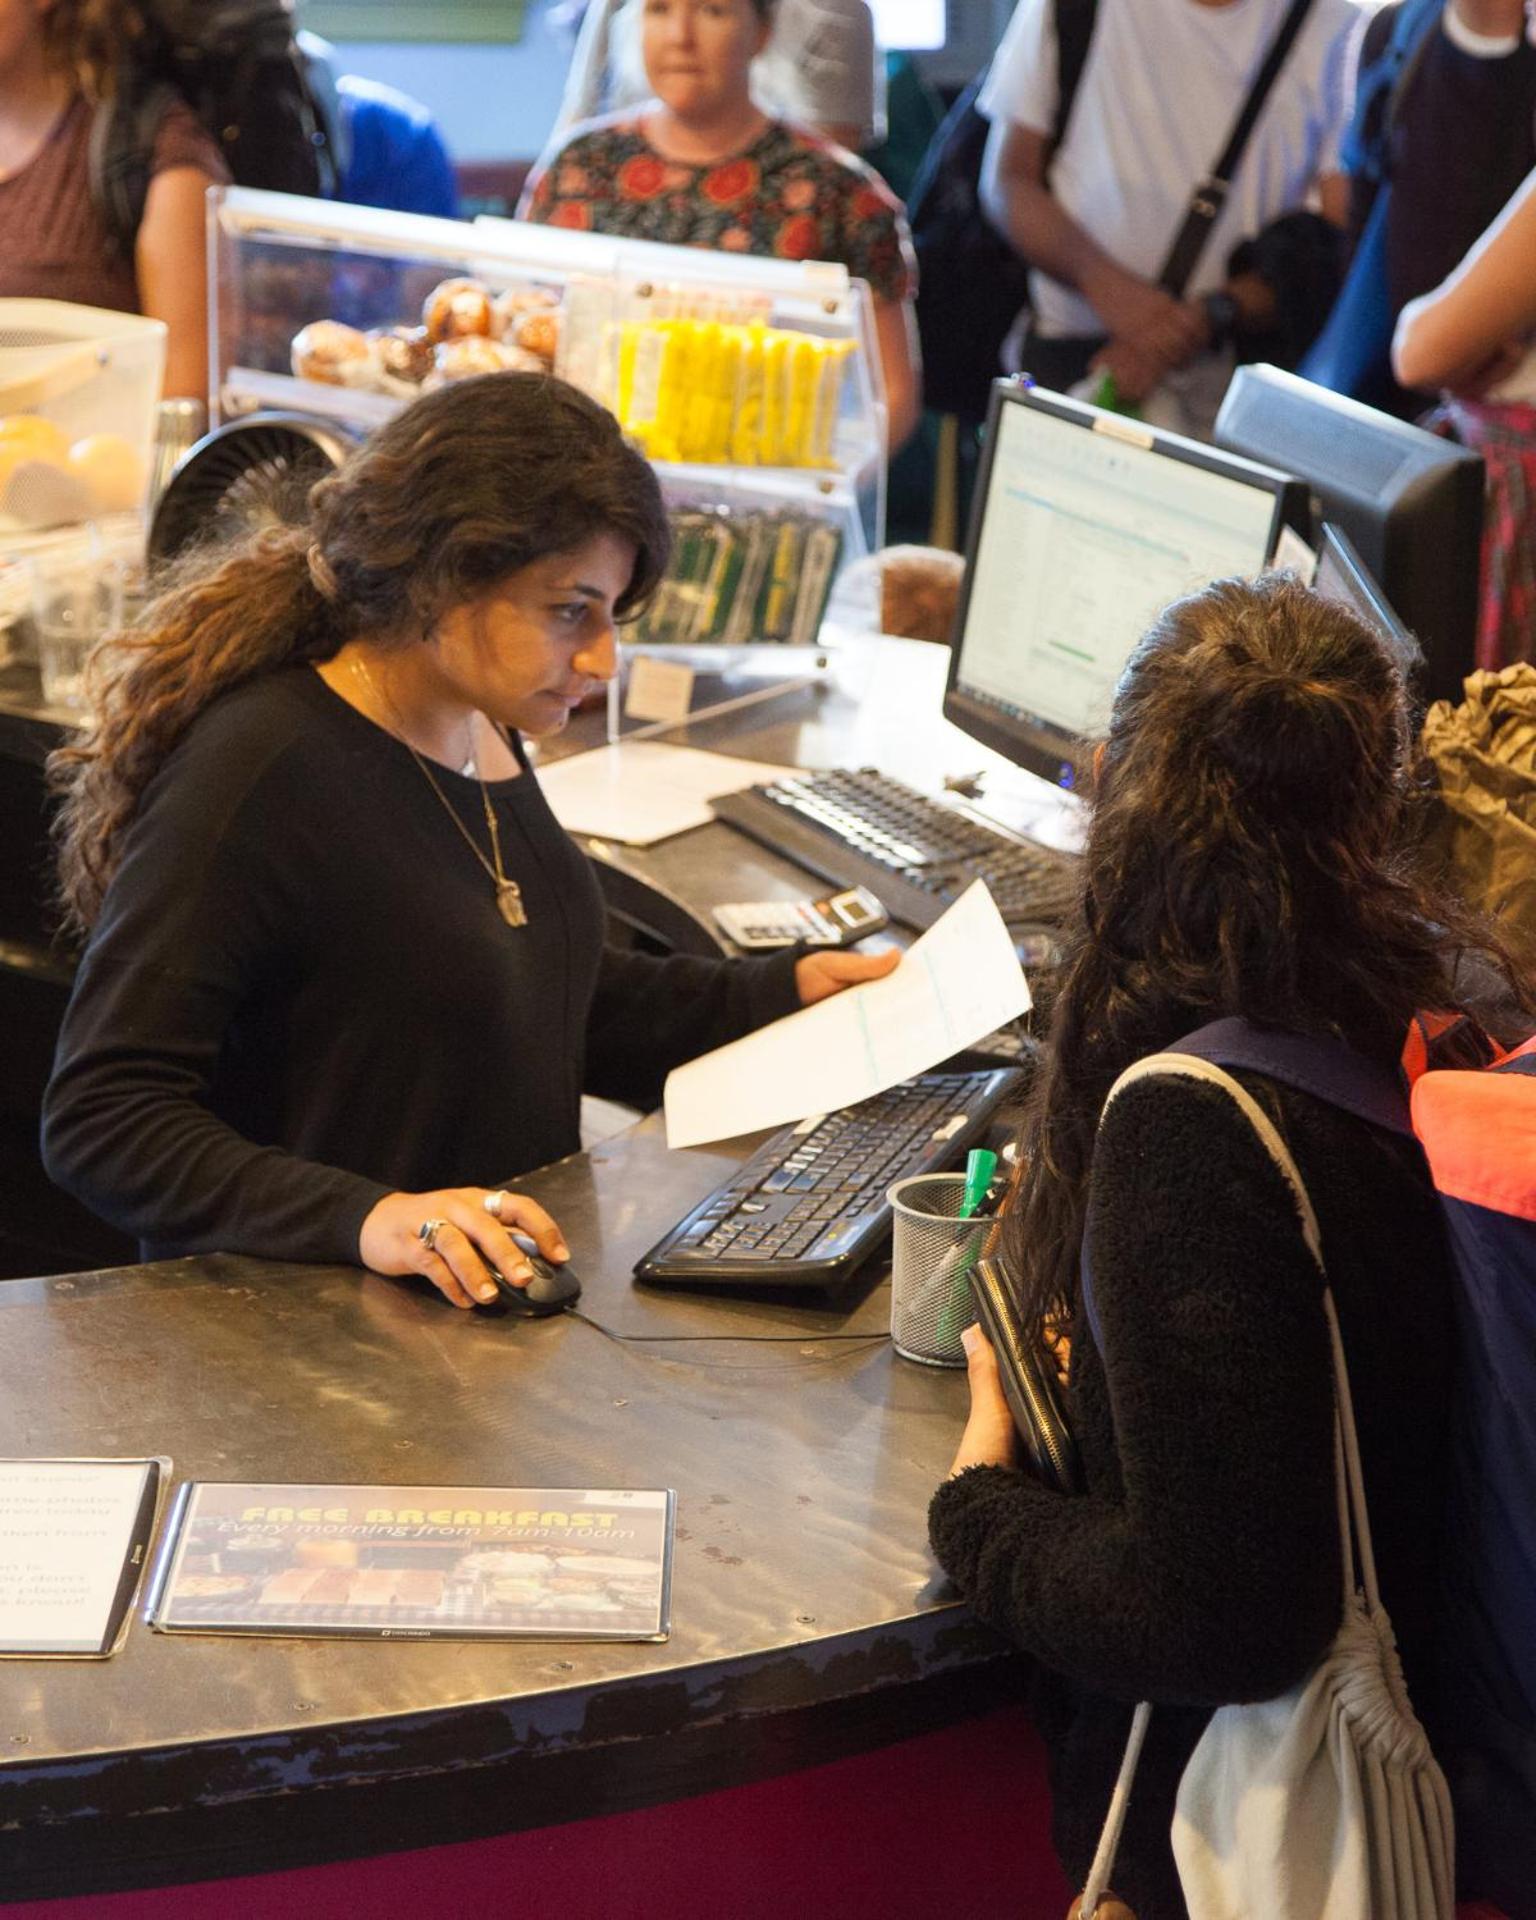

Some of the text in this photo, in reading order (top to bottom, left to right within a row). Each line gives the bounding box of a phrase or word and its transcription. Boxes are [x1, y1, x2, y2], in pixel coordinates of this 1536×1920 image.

[241, 1507, 618, 1527] FREE BREAKFAST
[217, 1521, 288, 1535] Every
[297, 1524, 410, 1537] morning
[413, 1522, 480, 1538] from
